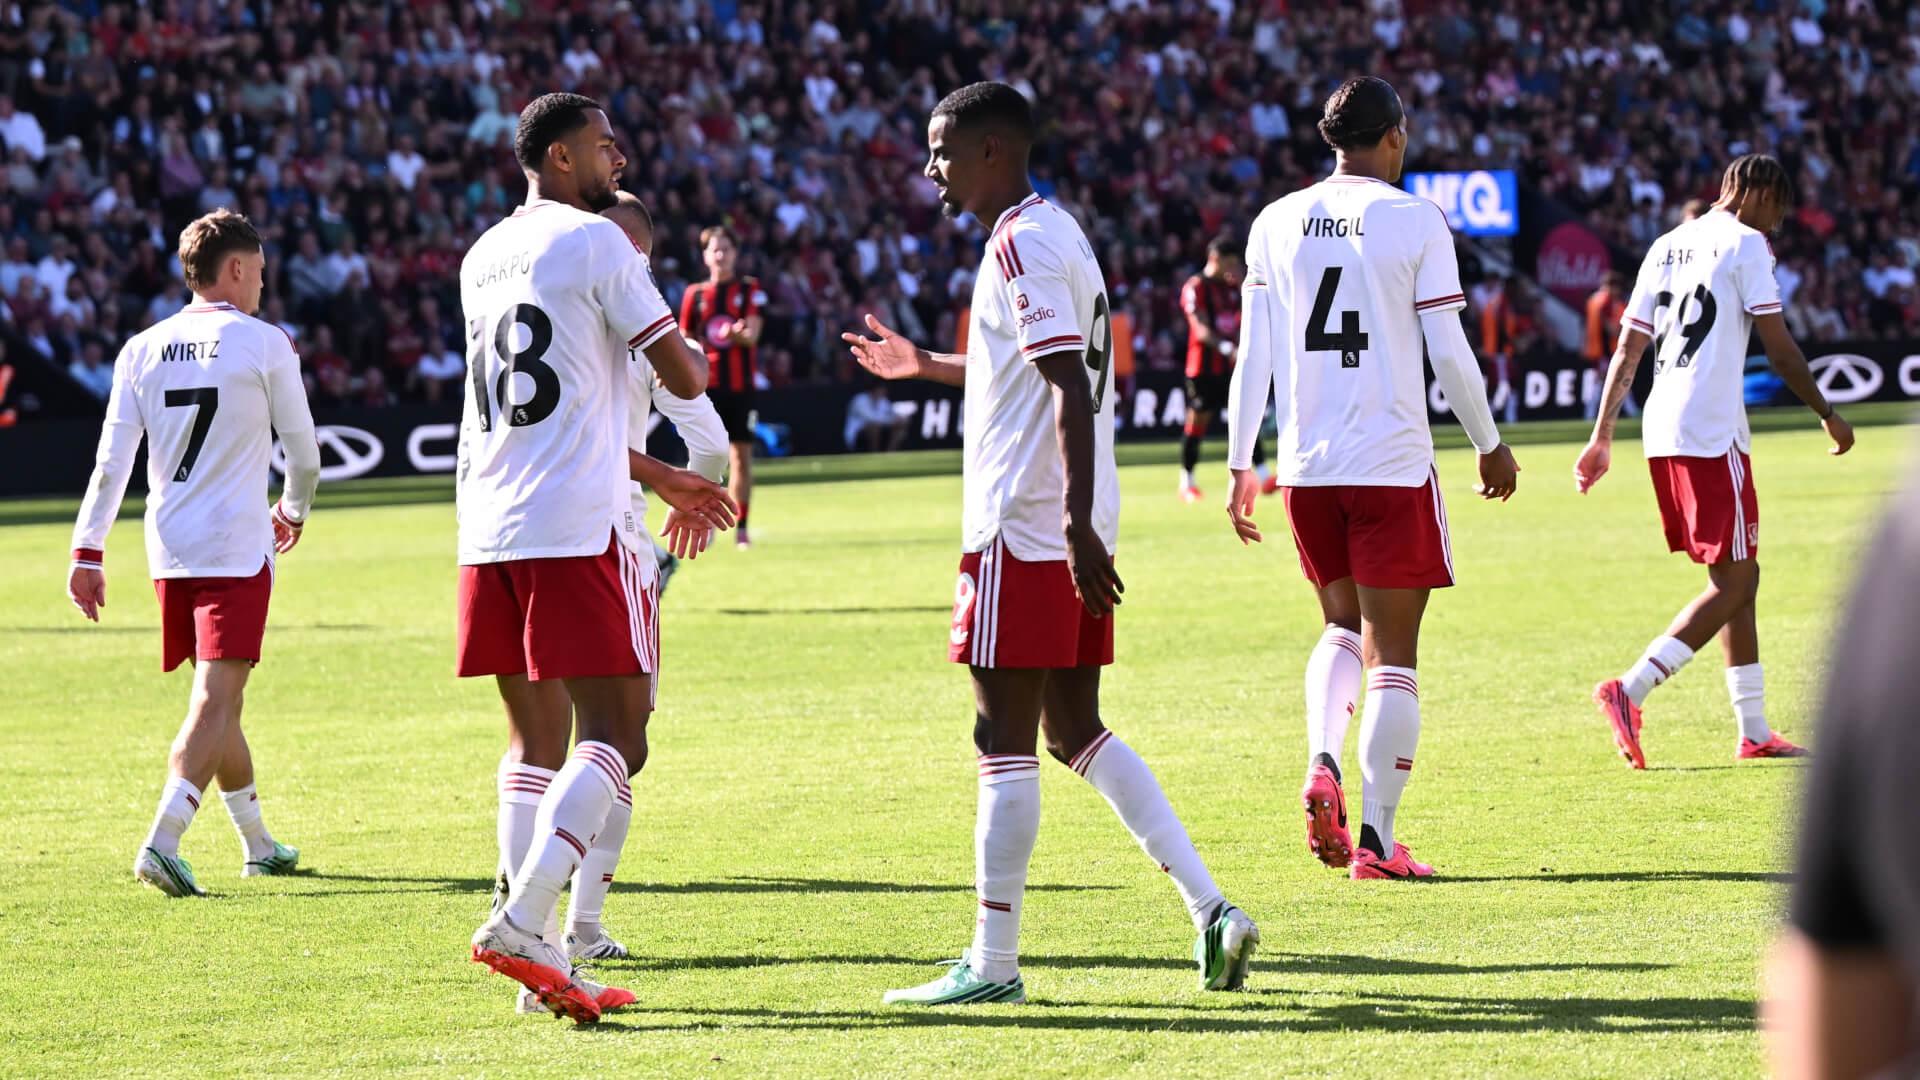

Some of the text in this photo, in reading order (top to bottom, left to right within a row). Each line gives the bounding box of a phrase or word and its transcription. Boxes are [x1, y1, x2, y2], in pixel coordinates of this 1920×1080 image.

[1301, 217, 1365, 238] VIRGIL
[160, 340, 220, 363] WIRTZ
[1304, 266, 1369, 369] 4
[470, 302, 561, 433] 18
[163, 386, 219, 483] 7
